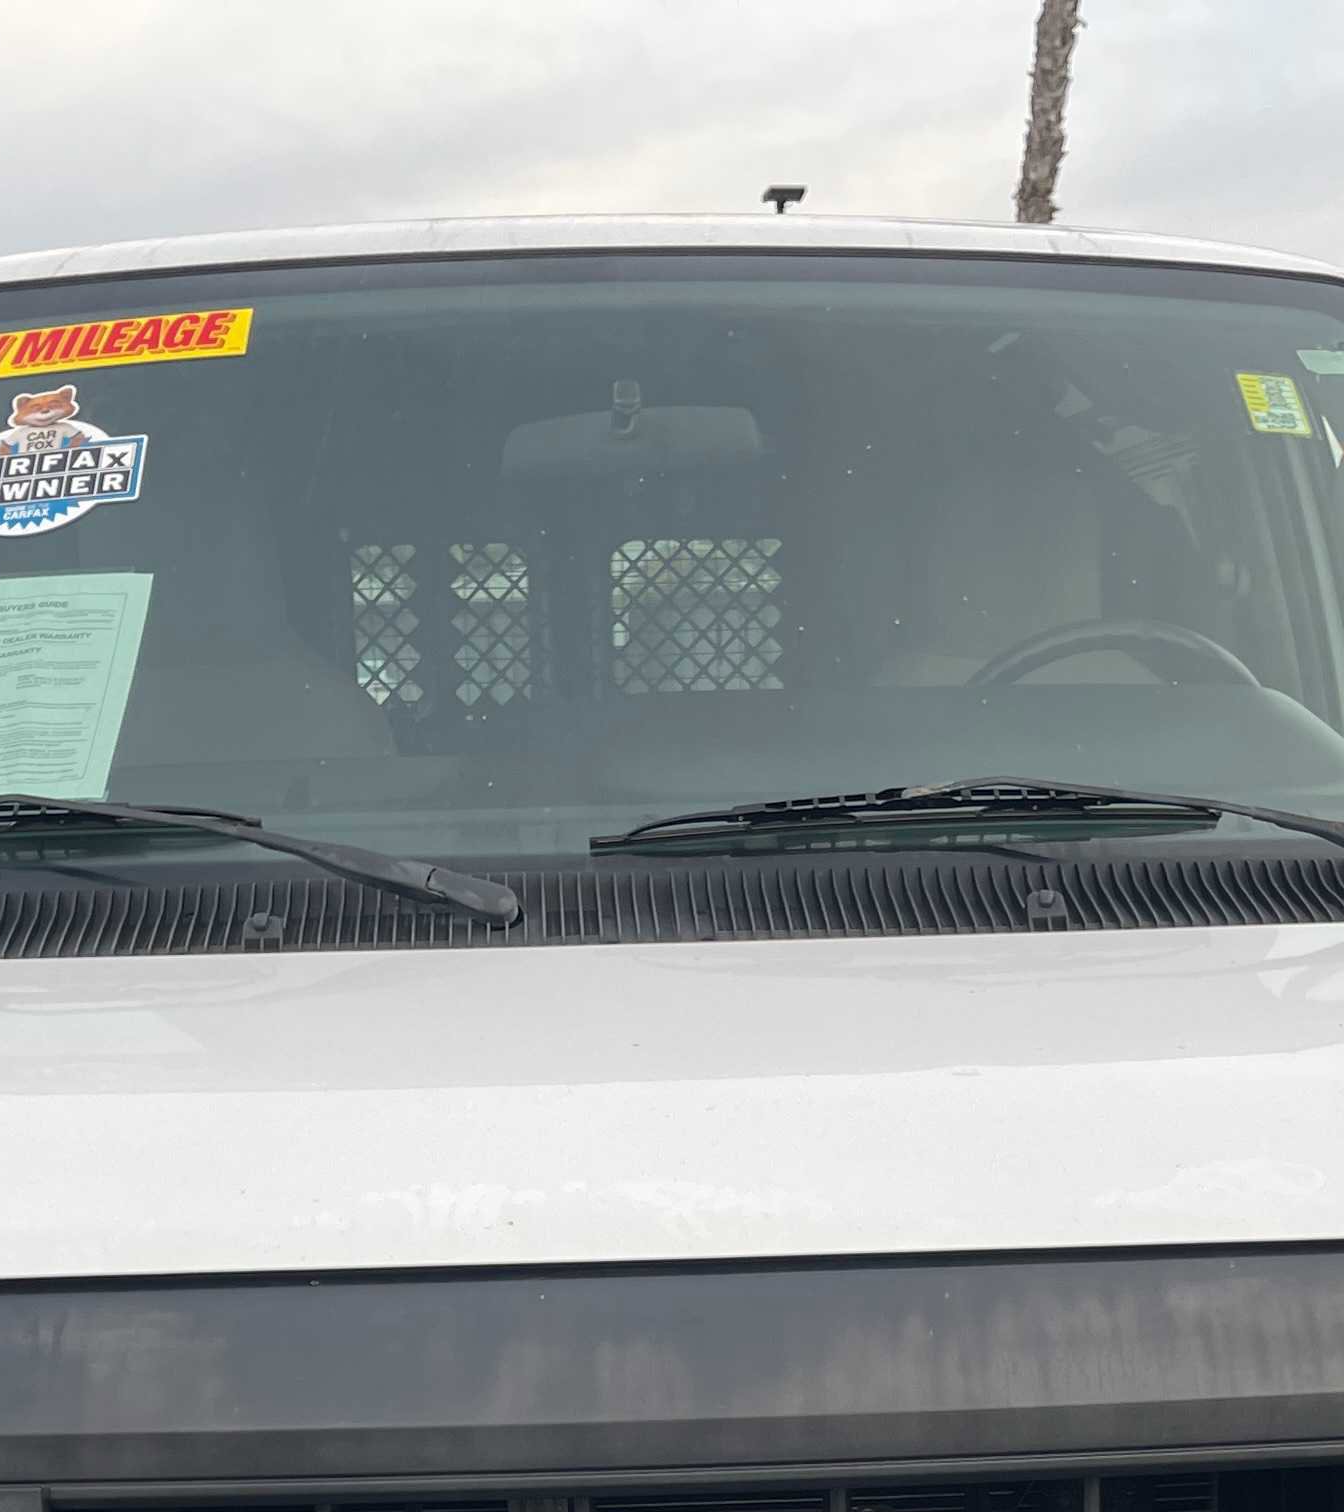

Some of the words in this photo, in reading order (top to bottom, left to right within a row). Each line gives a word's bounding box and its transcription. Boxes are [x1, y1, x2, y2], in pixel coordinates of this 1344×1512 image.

[11, 311, 237, 368] MILEAGE
[26, 430, 57, 442] CAR
[26, 440, 55, 451] FOX
[3, 508, 49, 520] CARFAX
